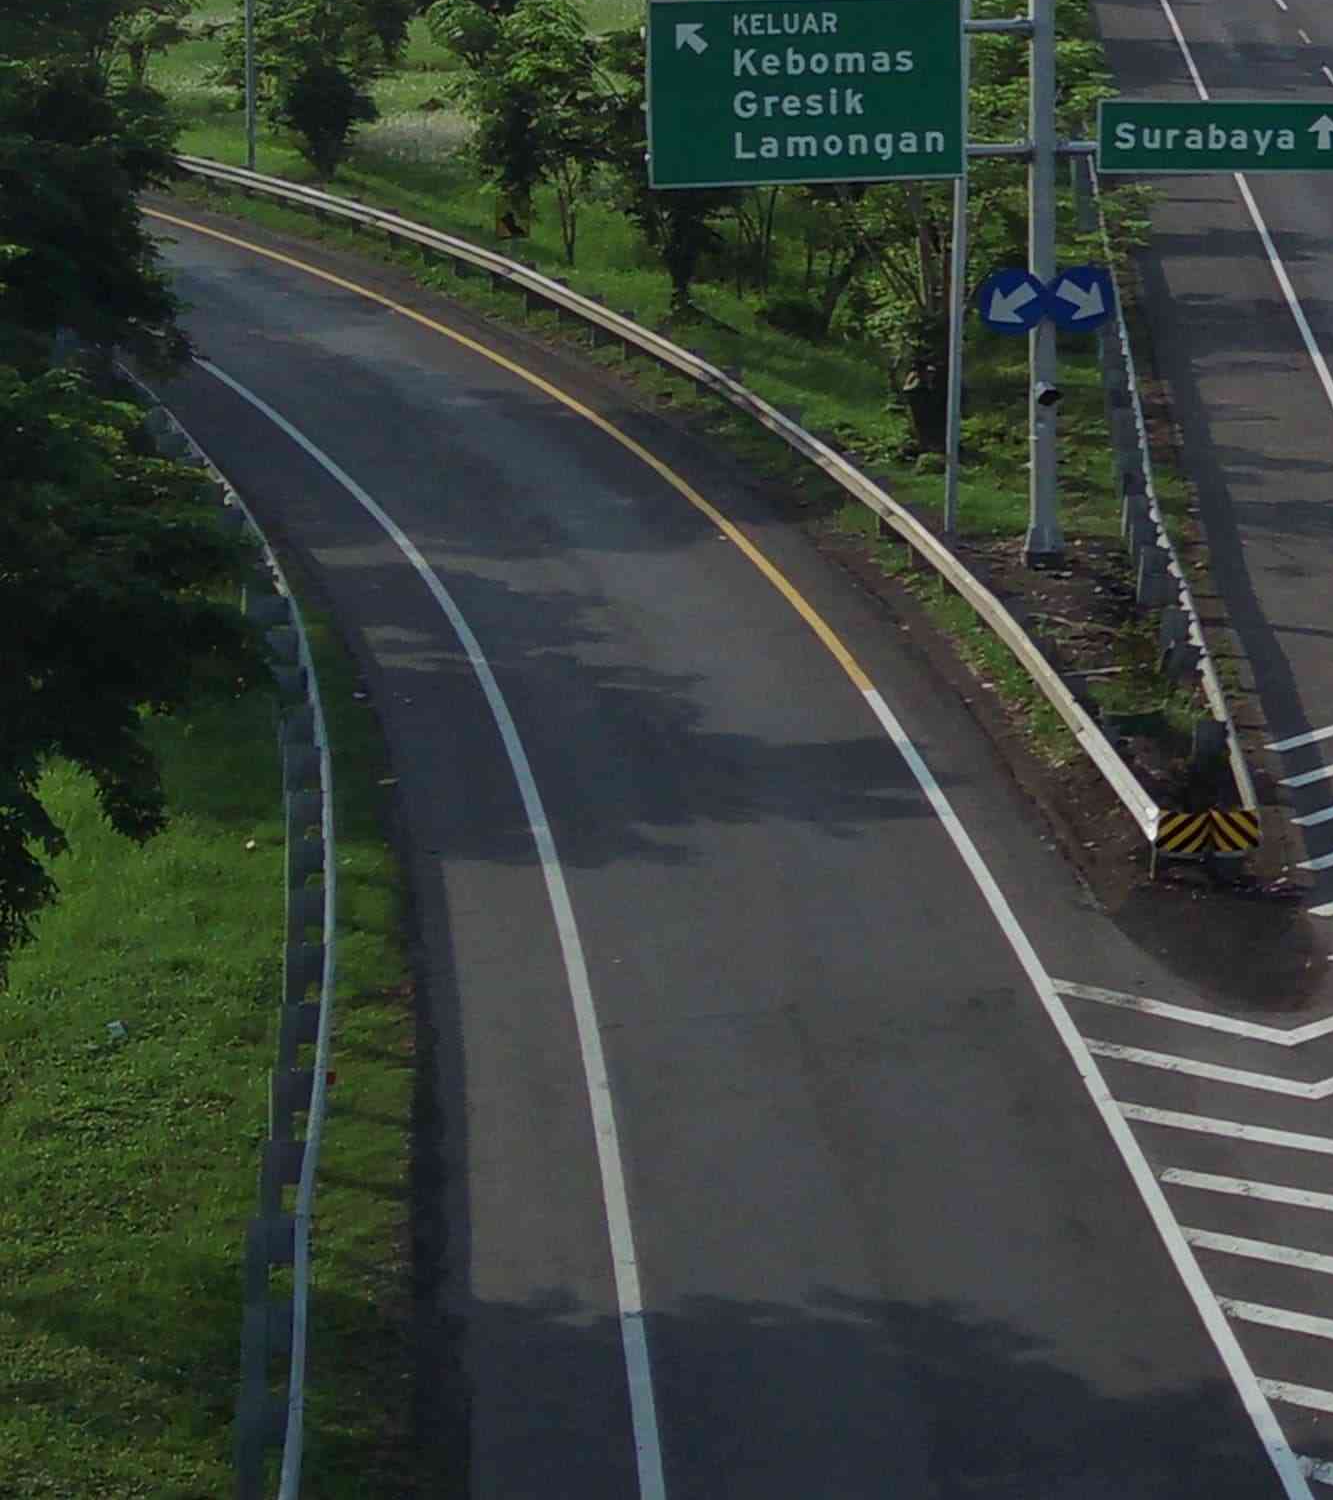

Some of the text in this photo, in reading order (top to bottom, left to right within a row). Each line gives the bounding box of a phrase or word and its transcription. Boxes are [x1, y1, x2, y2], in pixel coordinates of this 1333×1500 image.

[733, 12, 838, 35] KELUAR
[733, 47, 914, 77] Kebomas
[733, 88, 864, 118] Gresik
[734, 131, 945, 160] Lamongan
[1114, 122, 1295, 156] Surabaya
